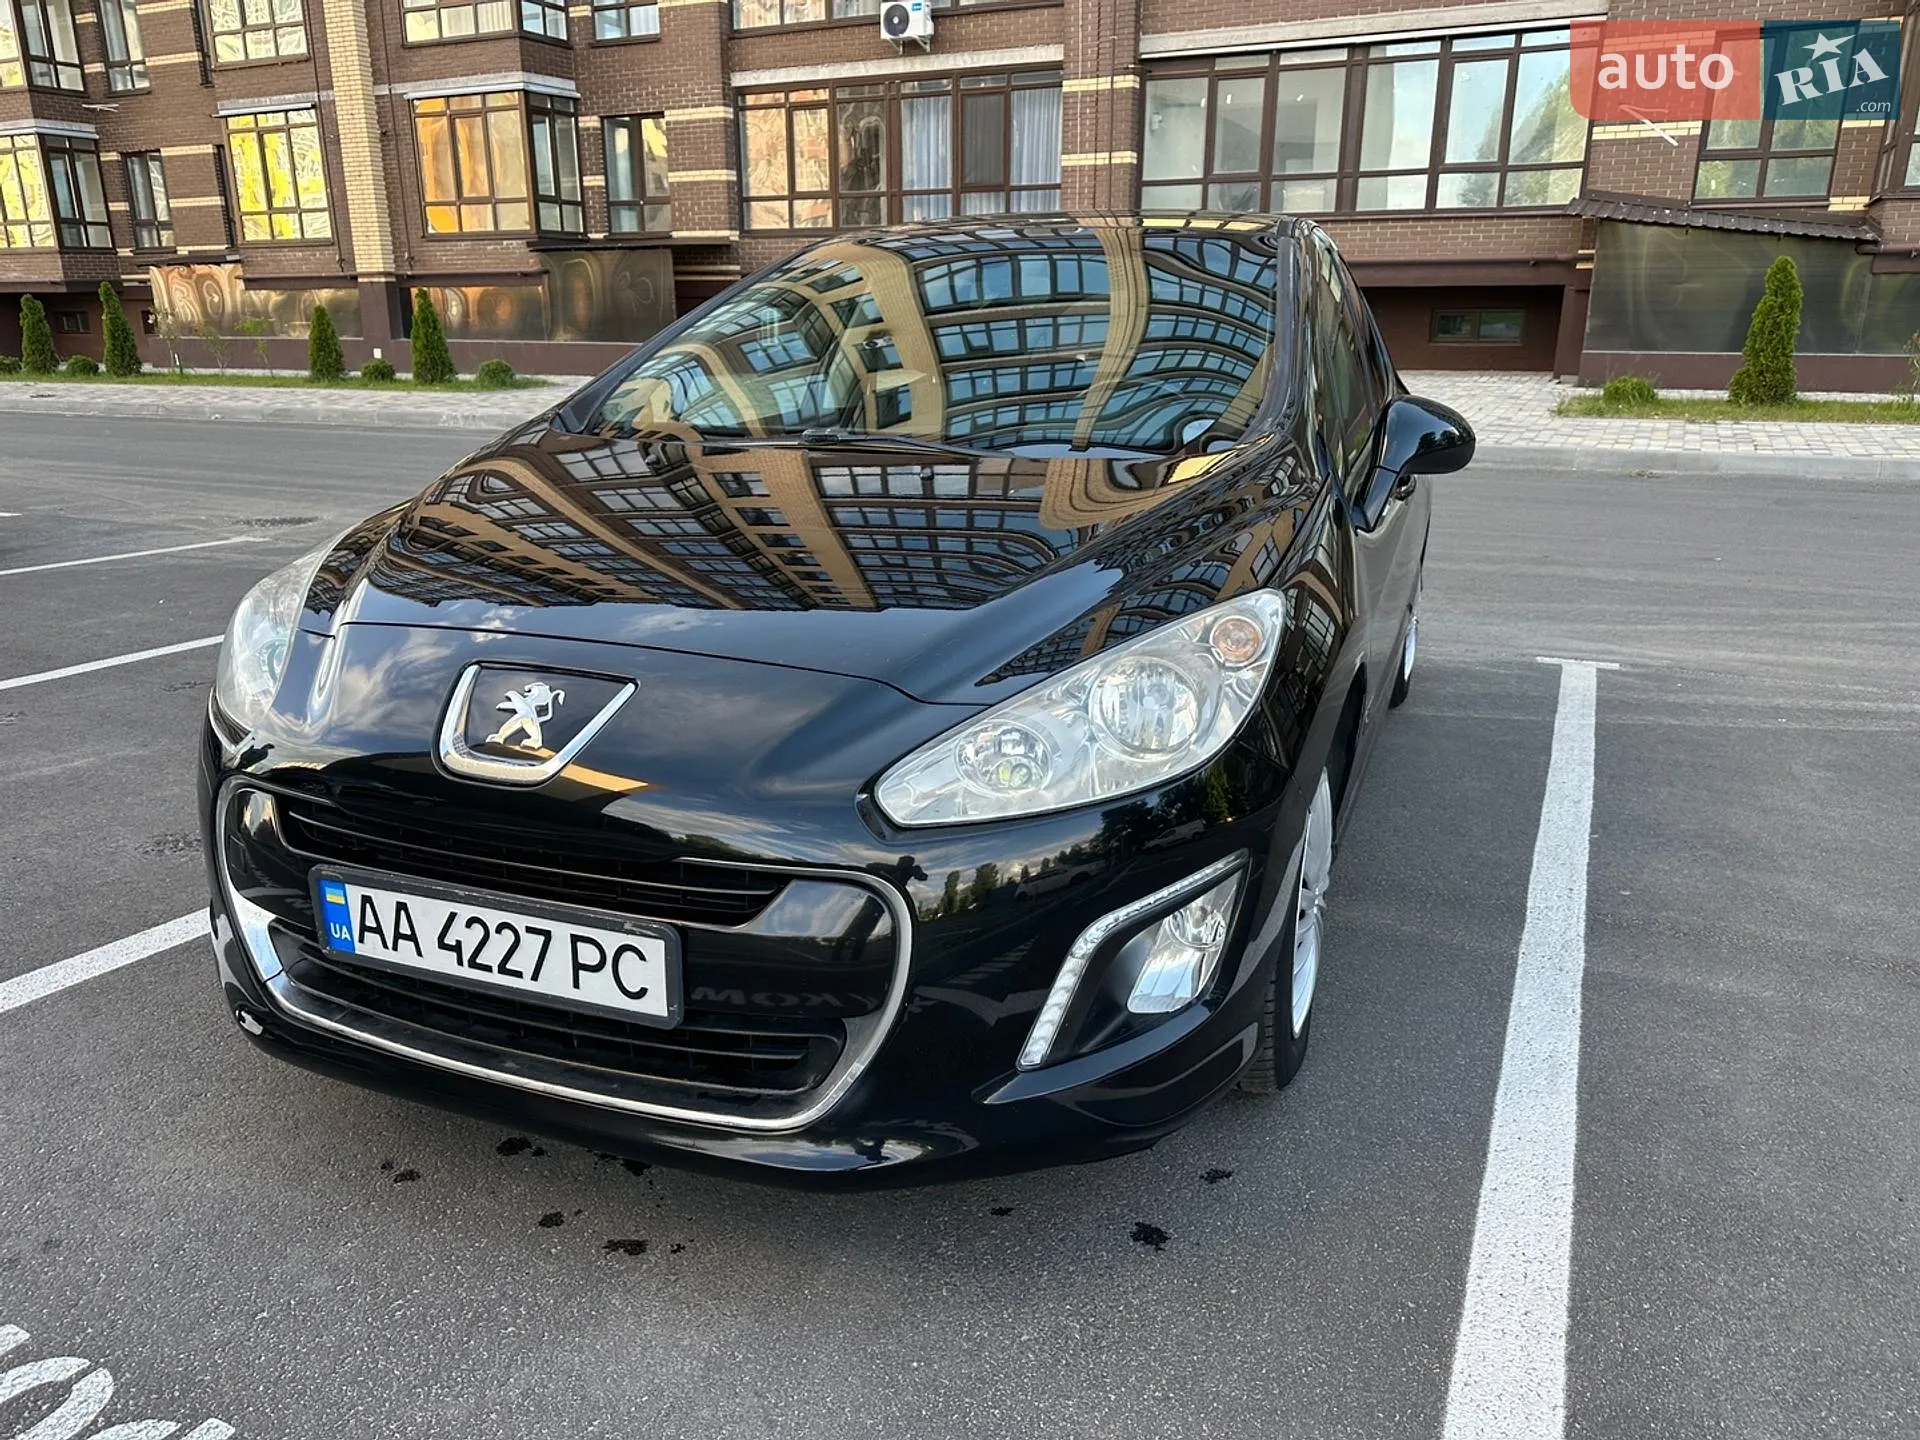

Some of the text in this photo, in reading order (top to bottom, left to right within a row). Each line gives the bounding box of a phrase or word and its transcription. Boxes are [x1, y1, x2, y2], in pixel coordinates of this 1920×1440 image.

[330, 922, 351, 942] UA
[358, 894, 648, 1000] AA 4227 PC
